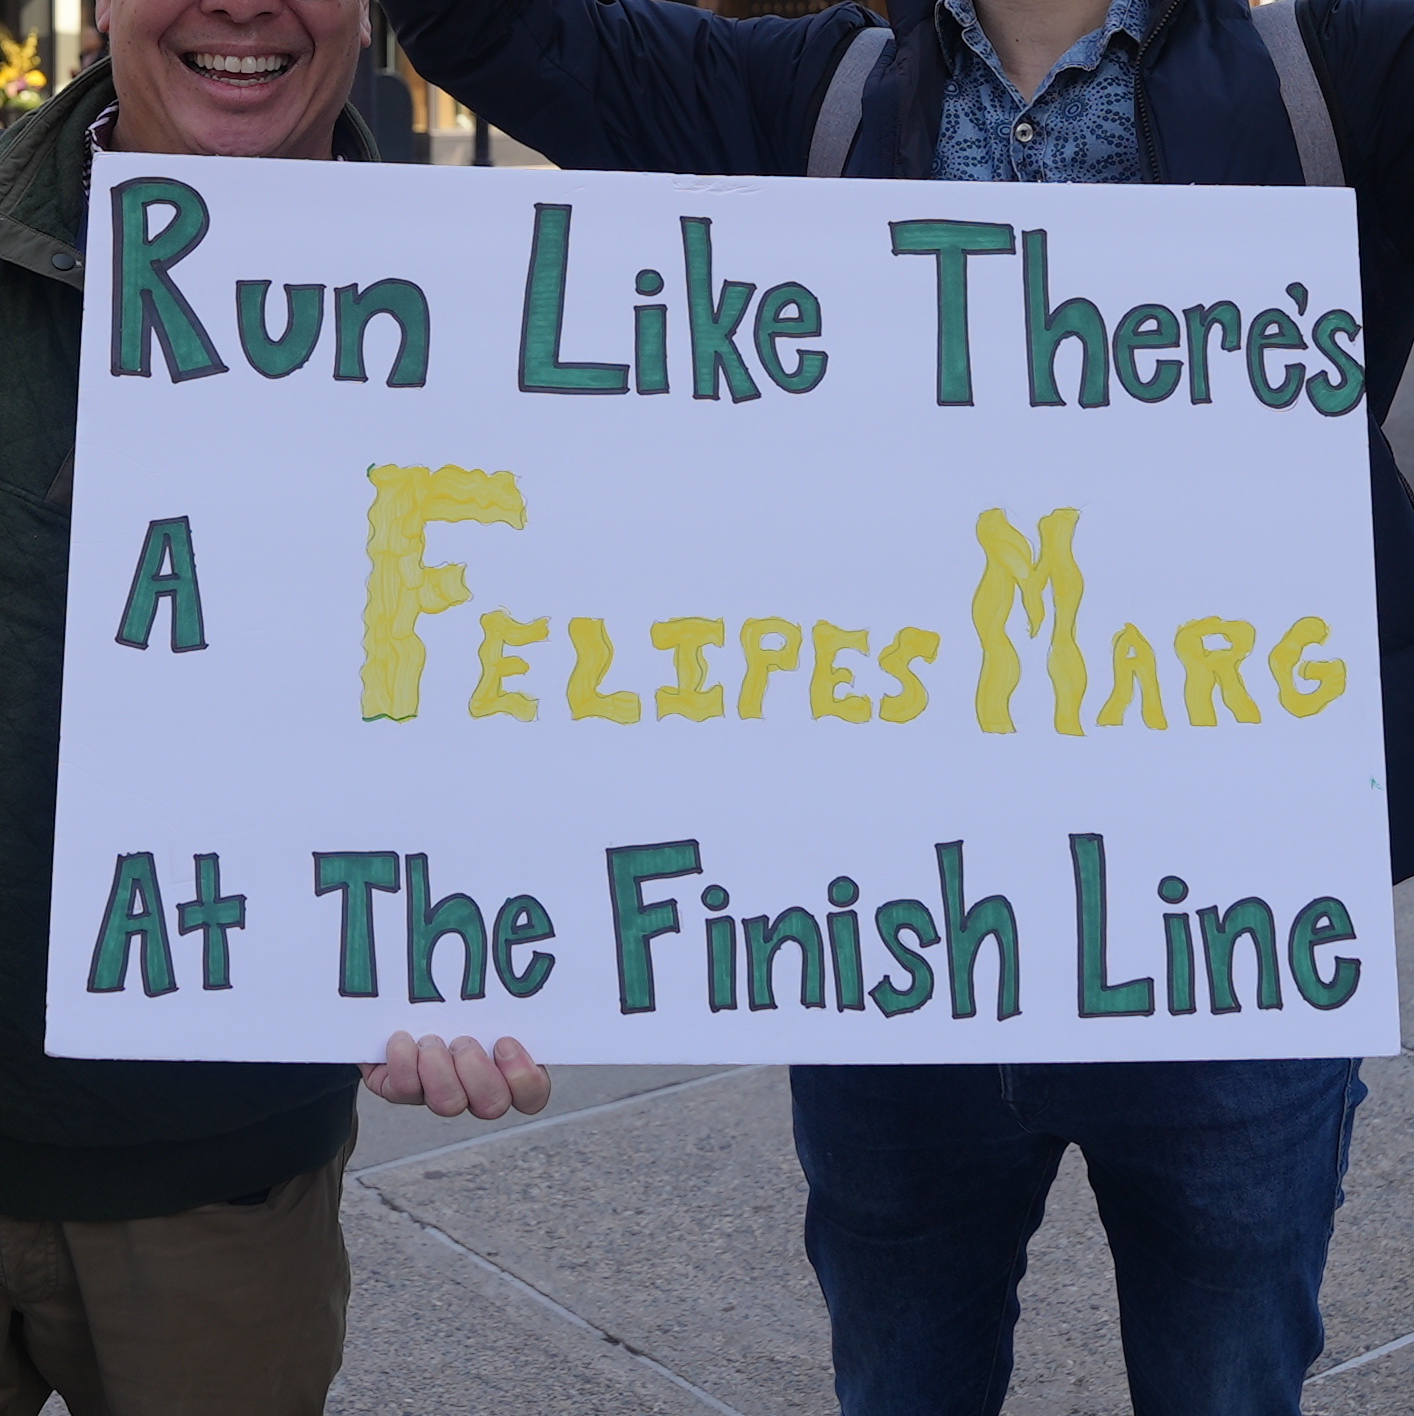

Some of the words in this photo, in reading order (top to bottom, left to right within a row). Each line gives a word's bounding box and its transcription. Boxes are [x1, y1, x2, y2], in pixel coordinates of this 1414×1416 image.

[109, 176, 431, 388] Run
[517, 202, 829, 403] Like
[888, 209, 1366, 418] There's
[114, 515, 209, 653] A
[360, 463, 941, 724] FELIPES
[972, 507, 1347, 737] MARG
[86, 851, 248, 997] At
[312, 850, 556, 1003] The
[606, 838, 1022, 1021] Finish
[1068, 832, 1361, 1019] Line
